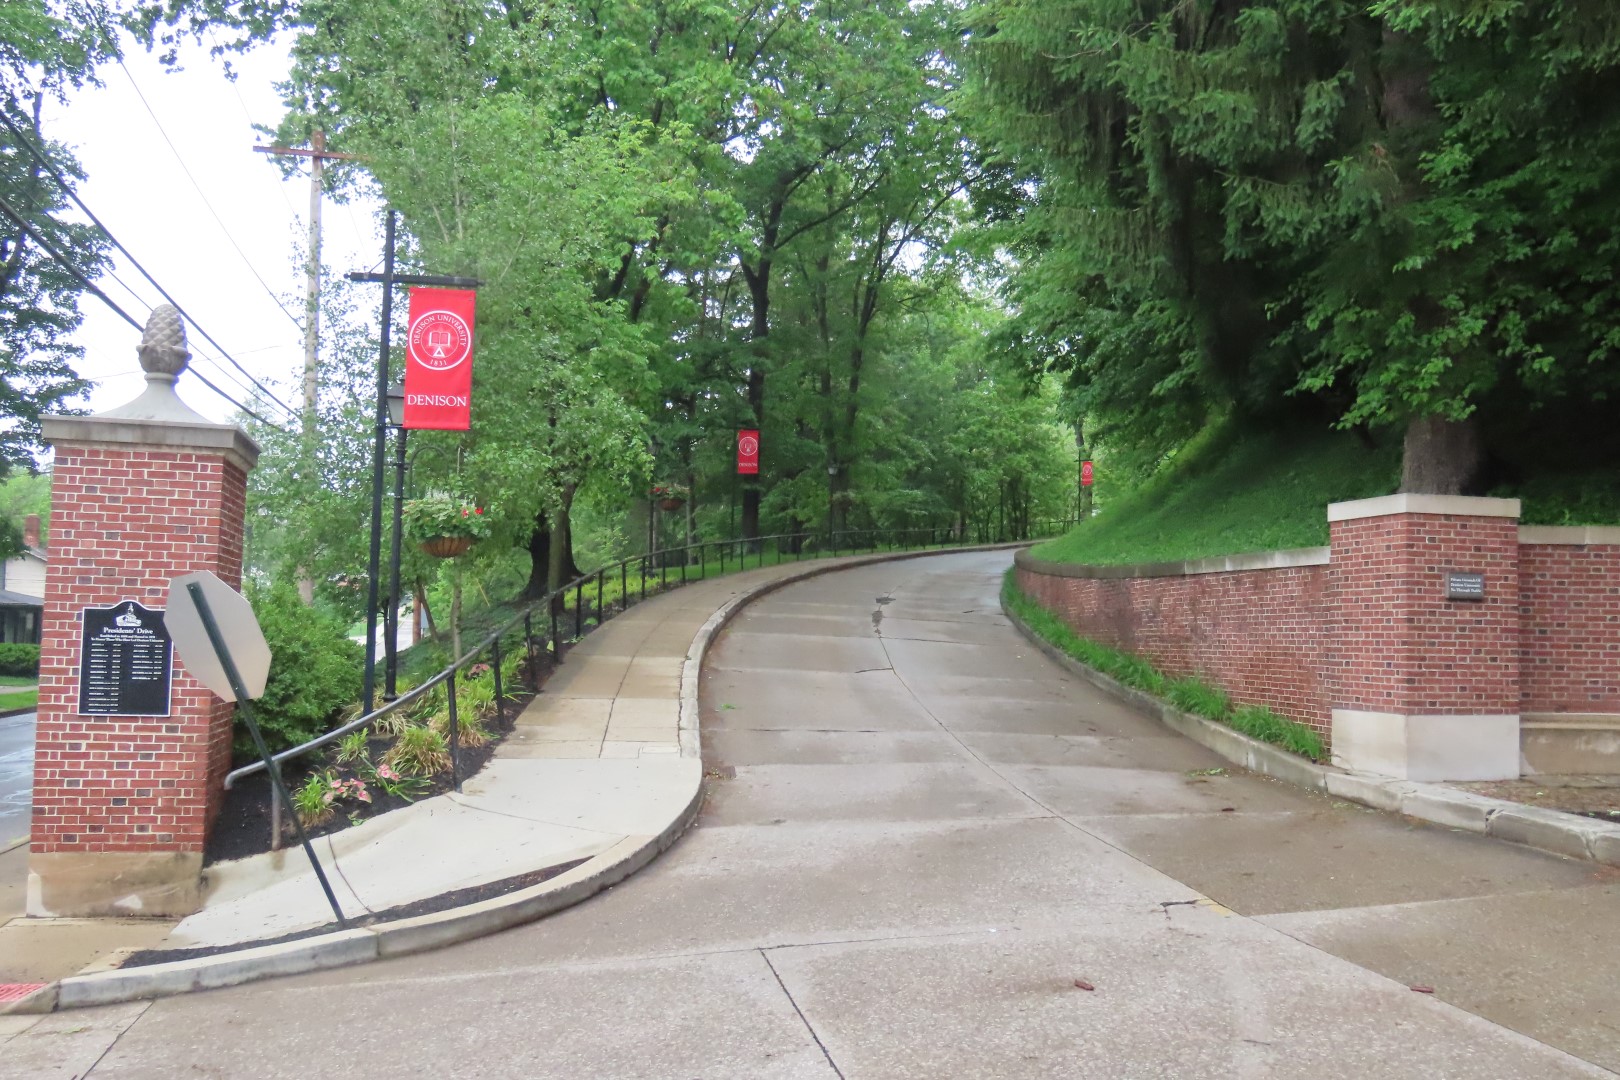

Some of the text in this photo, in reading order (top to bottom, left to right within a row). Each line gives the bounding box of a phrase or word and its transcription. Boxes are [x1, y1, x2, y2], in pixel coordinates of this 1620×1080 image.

[414, 315, 466, 346] DENISON UNIVERSITY
[408, 394, 466, 406] DENISON
